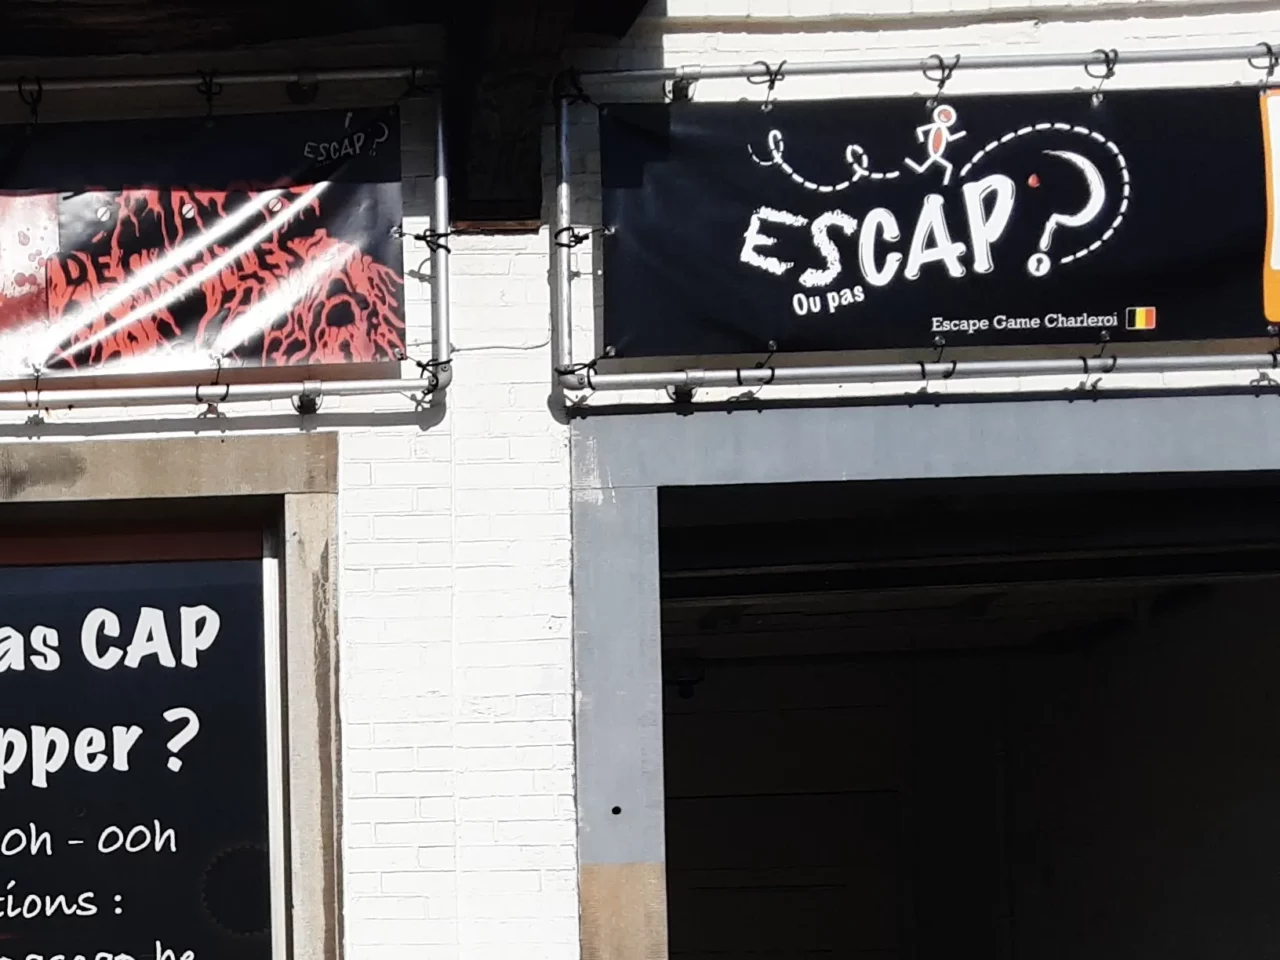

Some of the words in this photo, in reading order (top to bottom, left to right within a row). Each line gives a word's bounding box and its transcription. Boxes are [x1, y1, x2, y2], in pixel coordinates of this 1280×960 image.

[793, 287, 823, 315] Ou
[828, 282, 865, 314] pas
[932, 316, 989, 333] Escape
[994, 314, 1041, 330] Game
[1045, 311, 1118, 328] Charleroi
[81, 604, 221, 670] CAP
[98, 819, 177, 853] 00h
